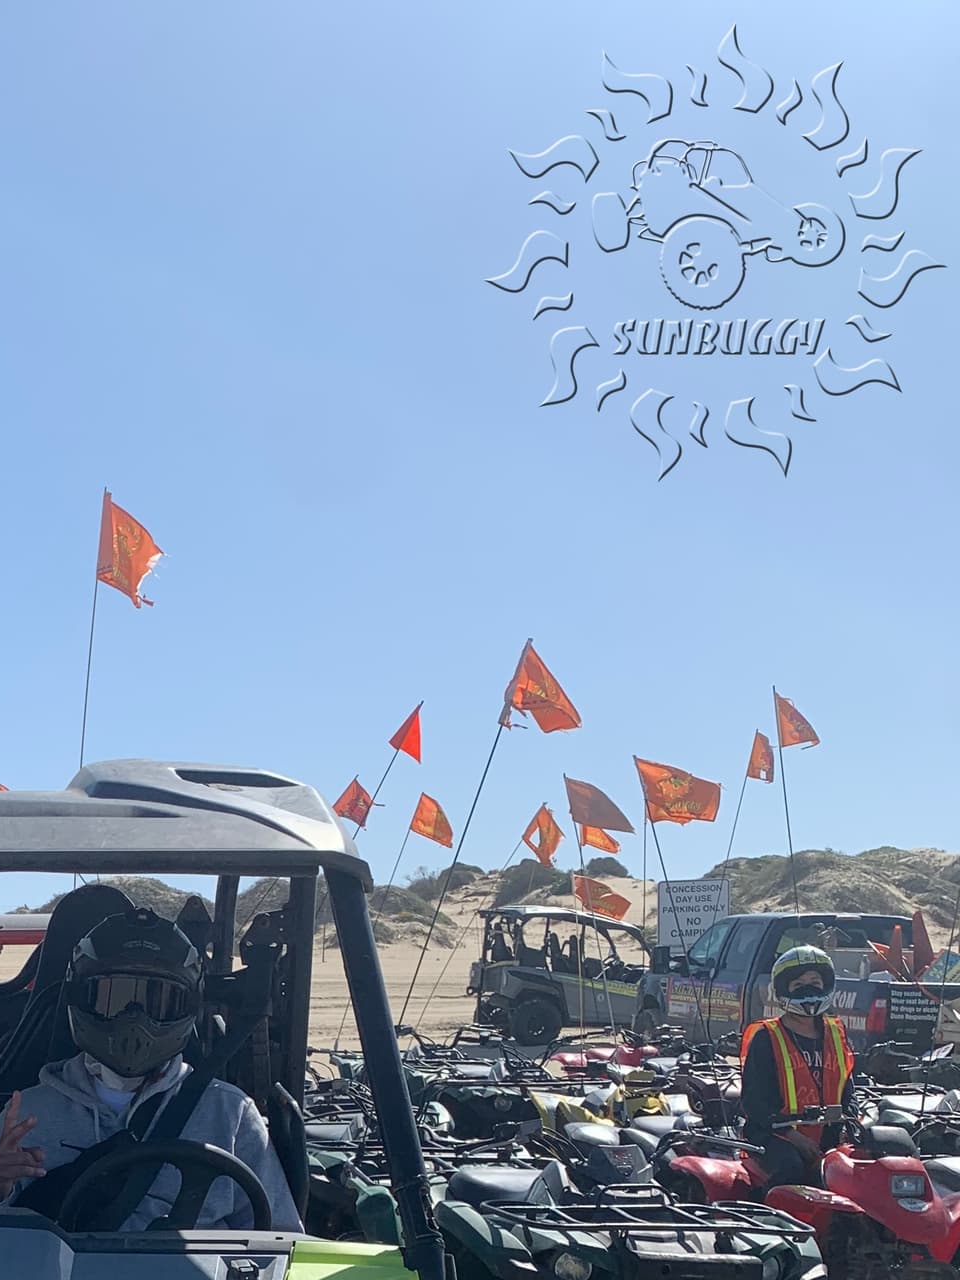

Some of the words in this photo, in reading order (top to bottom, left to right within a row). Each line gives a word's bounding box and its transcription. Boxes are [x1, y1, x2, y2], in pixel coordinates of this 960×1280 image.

[665, 884, 722, 893] CONCESSION
[675, 895, 693, 903] DAY
[694, 894, 713, 902] USE
[662, 905, 701, 914] PARKING
[702, 904, 726, 912] ONLY
[686, 917, 701, 926] NO
[670, 928, 706, 938] CAMPI
